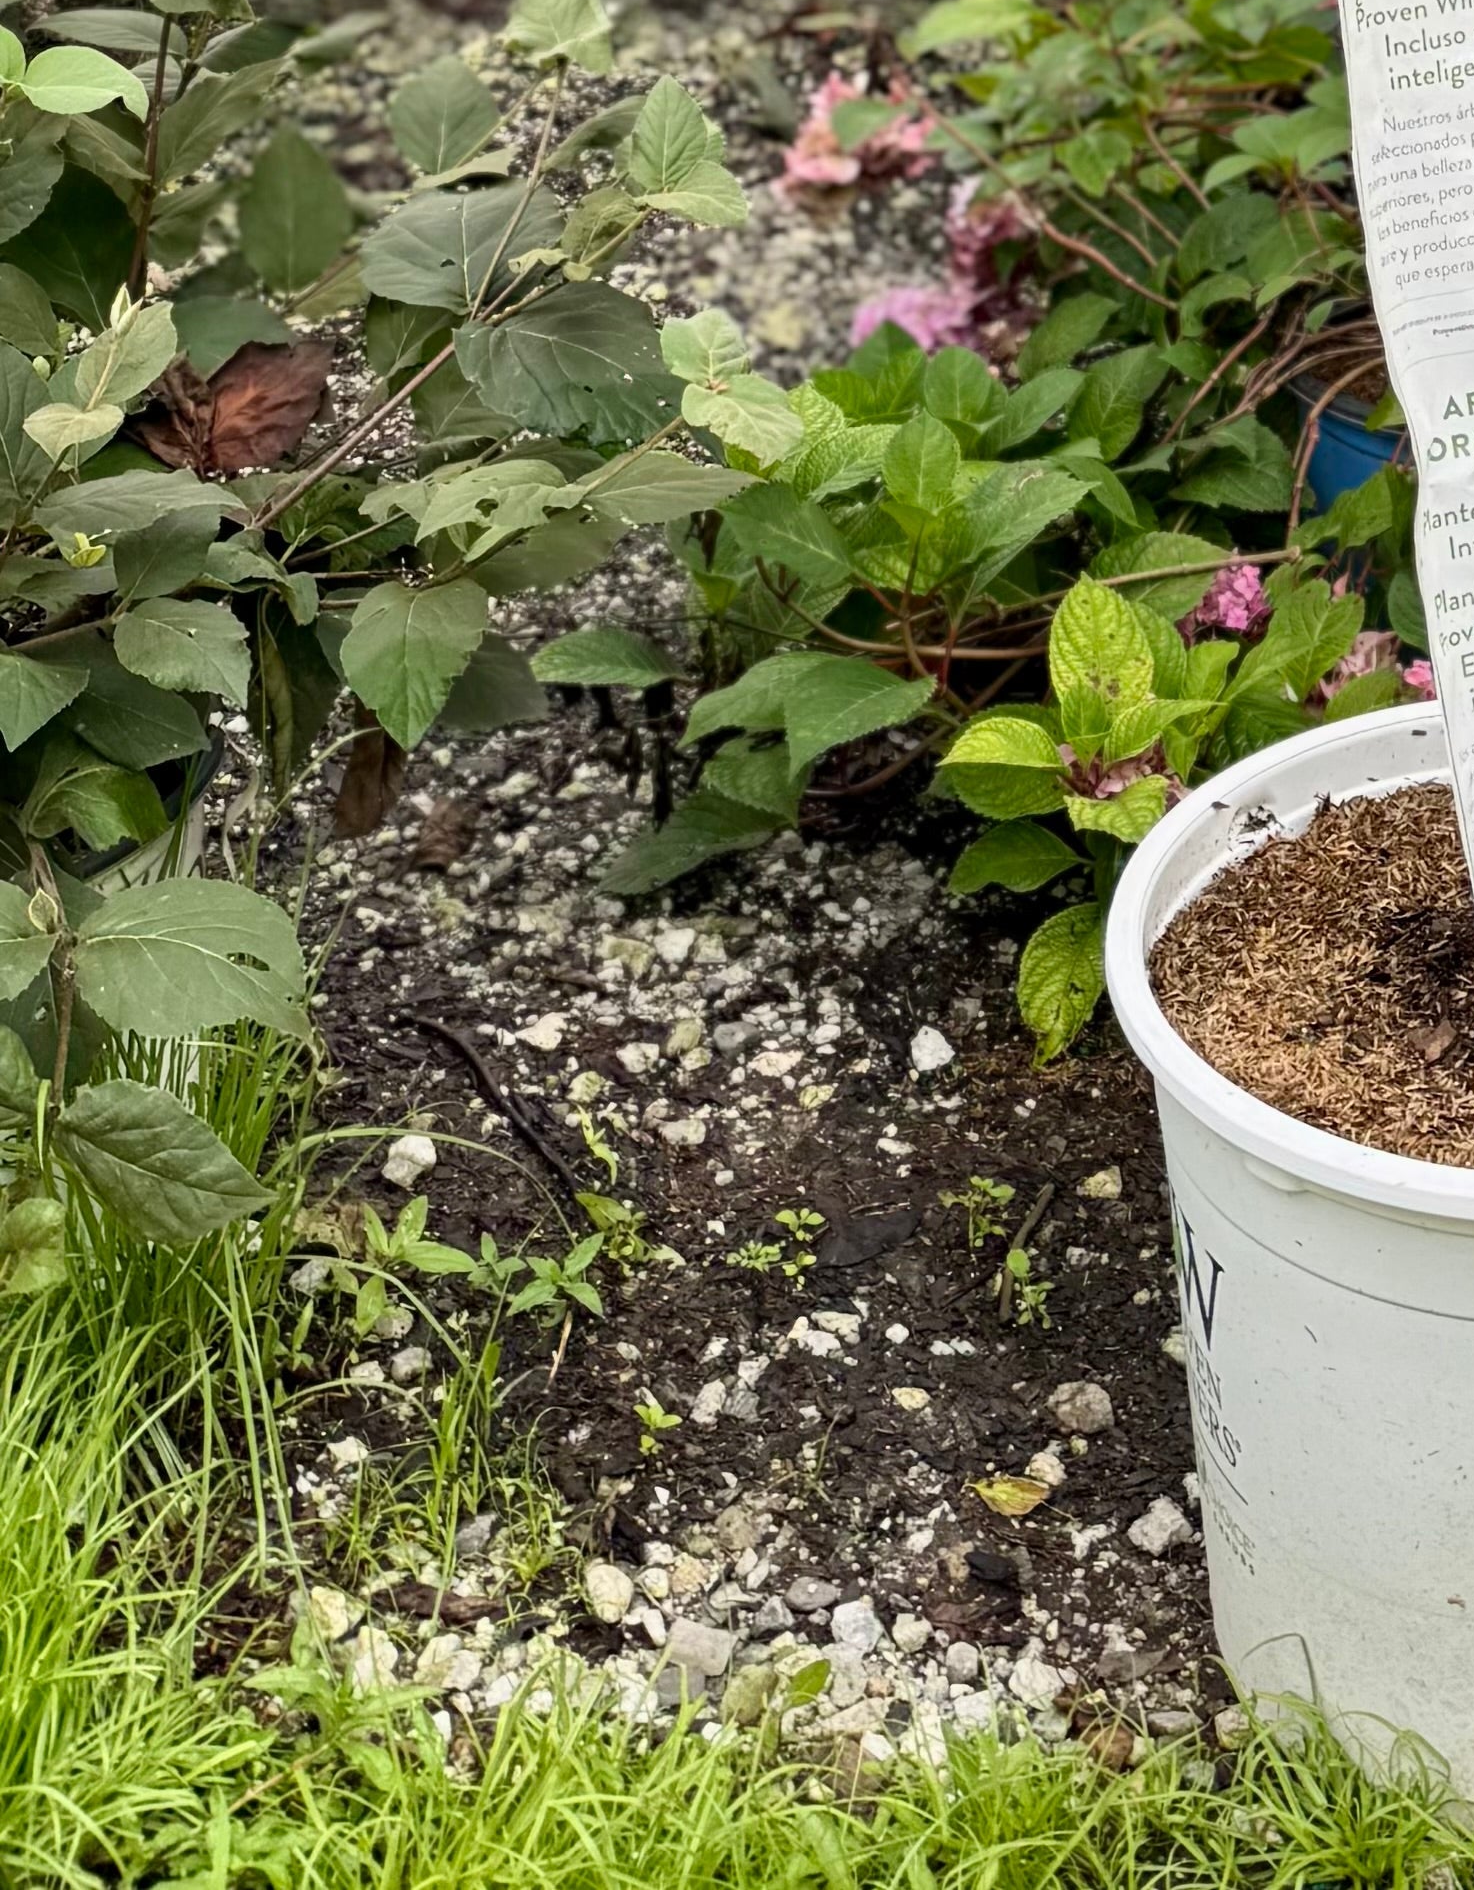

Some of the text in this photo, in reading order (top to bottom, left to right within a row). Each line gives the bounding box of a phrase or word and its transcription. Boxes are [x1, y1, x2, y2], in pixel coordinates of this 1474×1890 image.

[1356, 4, 1428, 33] Proven
[1385, 28, 1466, 57] Incluso
[1383, 112, 1452, 133] Nuestros
[1390, 168, 1417, 183] una
[1422, 157, 1472, 177] belleza
[1439, 184, 1473, 206] pero
[1392, 210, 1469, 234] beneficios
[1395, 270, 1420, 290] que
[1424, 261, 1474, 281] espera
